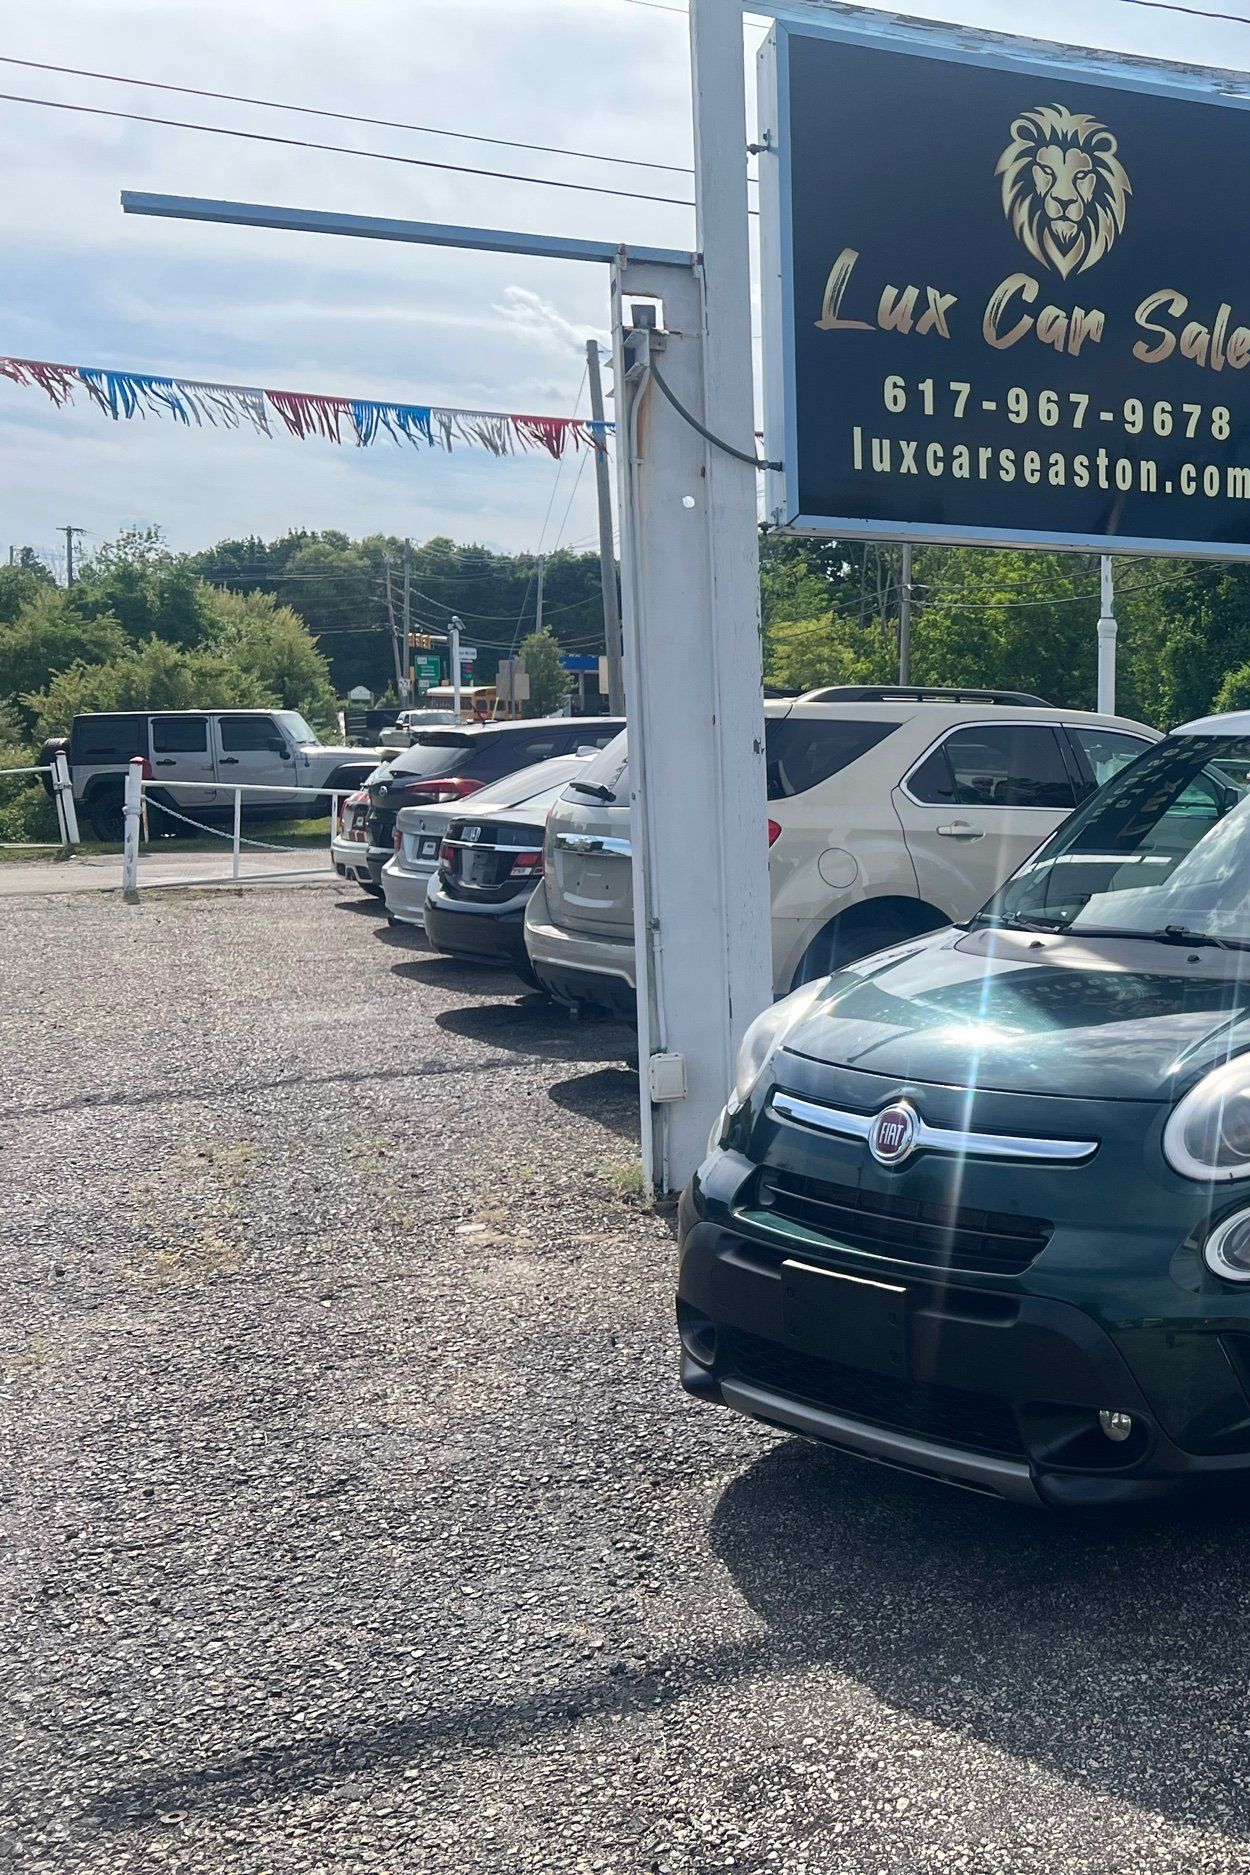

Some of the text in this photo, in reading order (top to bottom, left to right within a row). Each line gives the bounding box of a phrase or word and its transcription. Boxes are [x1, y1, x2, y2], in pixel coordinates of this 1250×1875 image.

[813, 248, 958, 339] Lux
[982, 272, 1105, 357] Car
[883, 375, 1231, 441] 617-967-9678
[879, 1122, 904, 1146] FIAT
